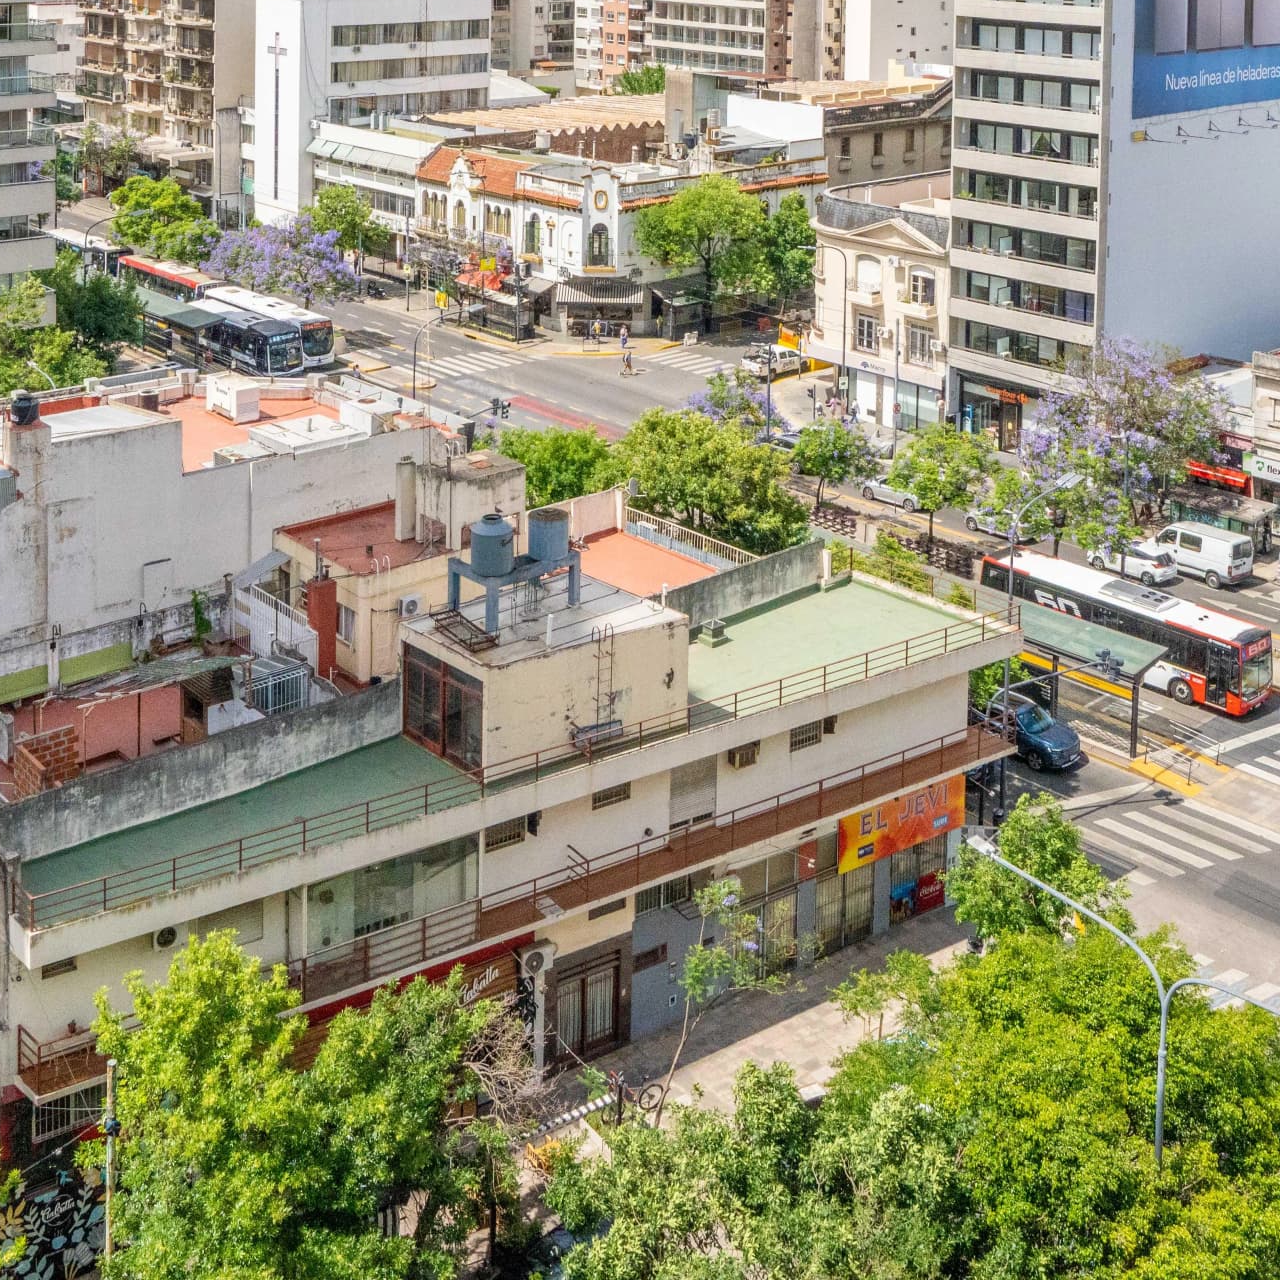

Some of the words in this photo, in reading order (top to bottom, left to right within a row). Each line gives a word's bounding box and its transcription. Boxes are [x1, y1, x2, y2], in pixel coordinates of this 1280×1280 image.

[1165, 73, 1198, 90] Nueva
[1199, 68, 1222, 86] línea
[1222, 67, 1235, 83] de
[1248, 638, 1267, 657] 60
[860, 806, 888, 837] EL
[898, 783, 949, 824] JEVI
